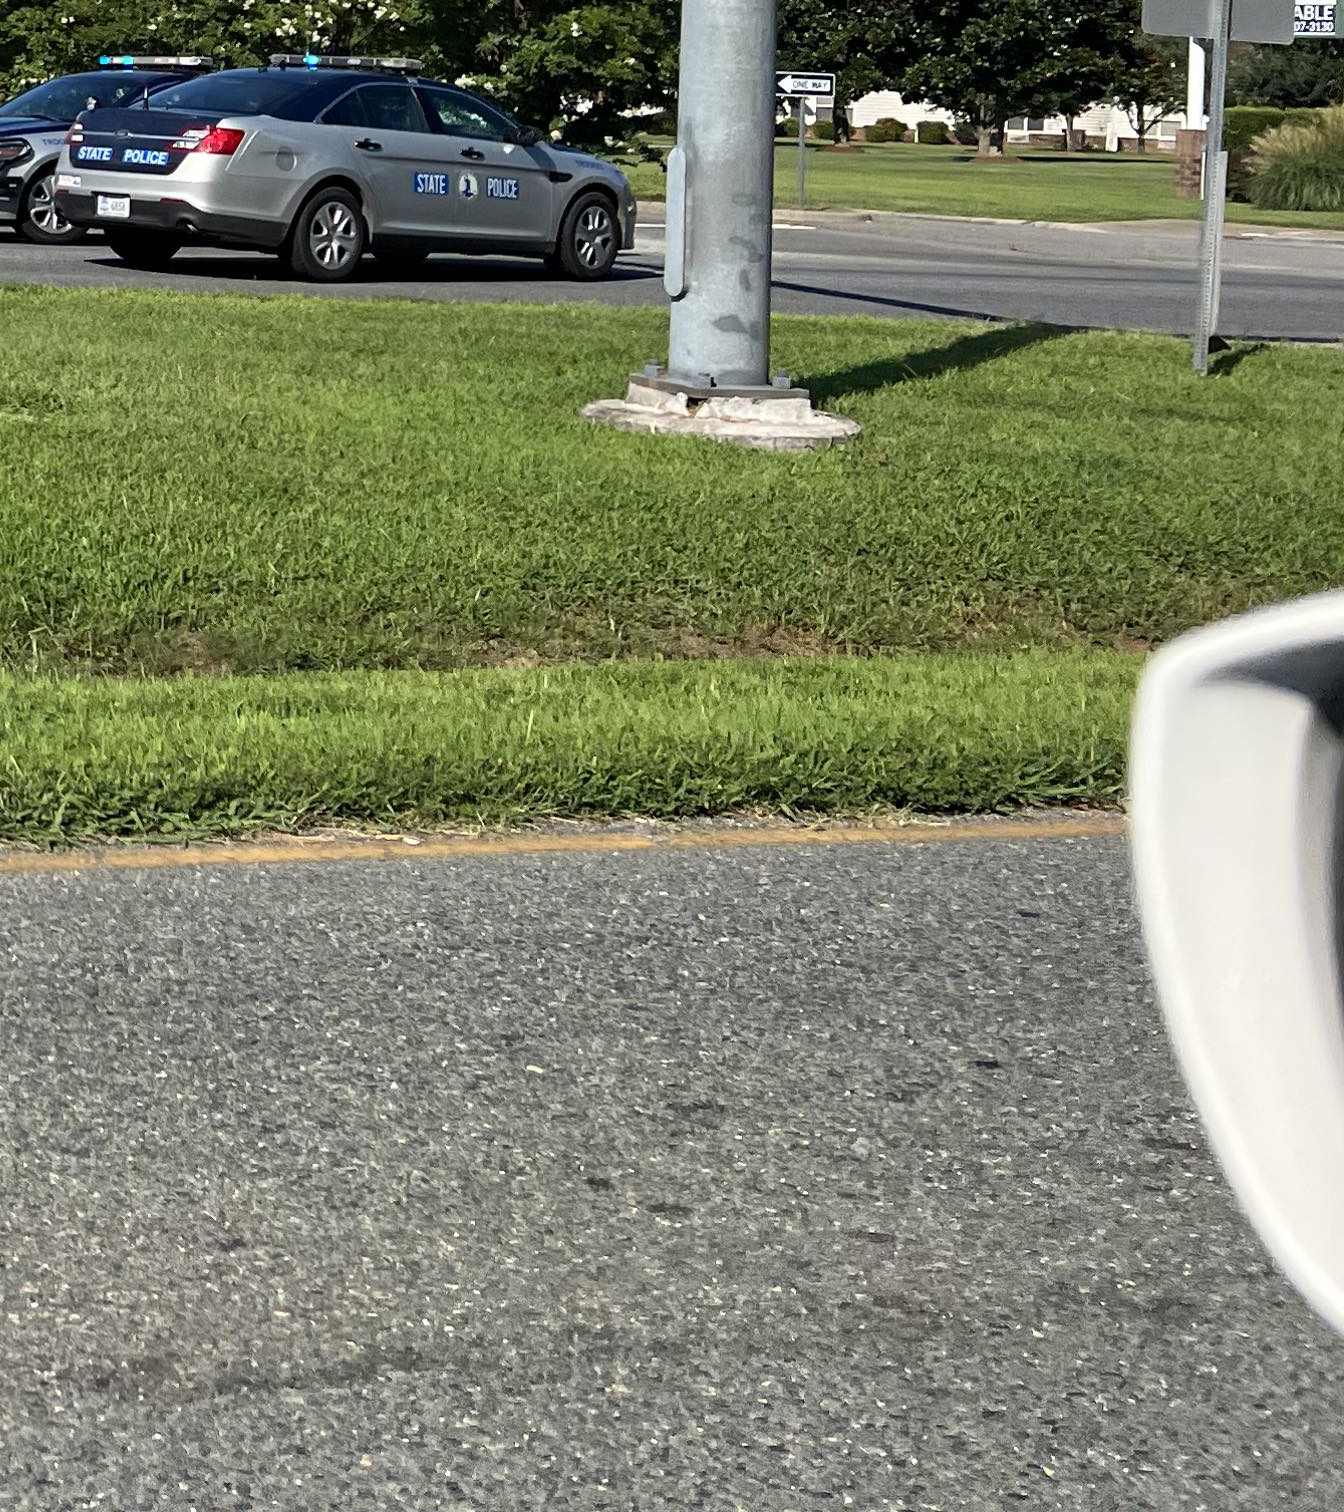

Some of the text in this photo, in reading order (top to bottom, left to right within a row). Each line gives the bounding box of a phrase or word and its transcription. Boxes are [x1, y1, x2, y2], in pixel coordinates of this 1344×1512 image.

[1294, 5, 1334, 20] ABLE
[1294, 21, 1334, 32] 07-3130
[793, 80, 808, 89] ONE
[78, 147, 168, 165] STATE POLICE
[417, 173, 517, 199] STATE POLICE
